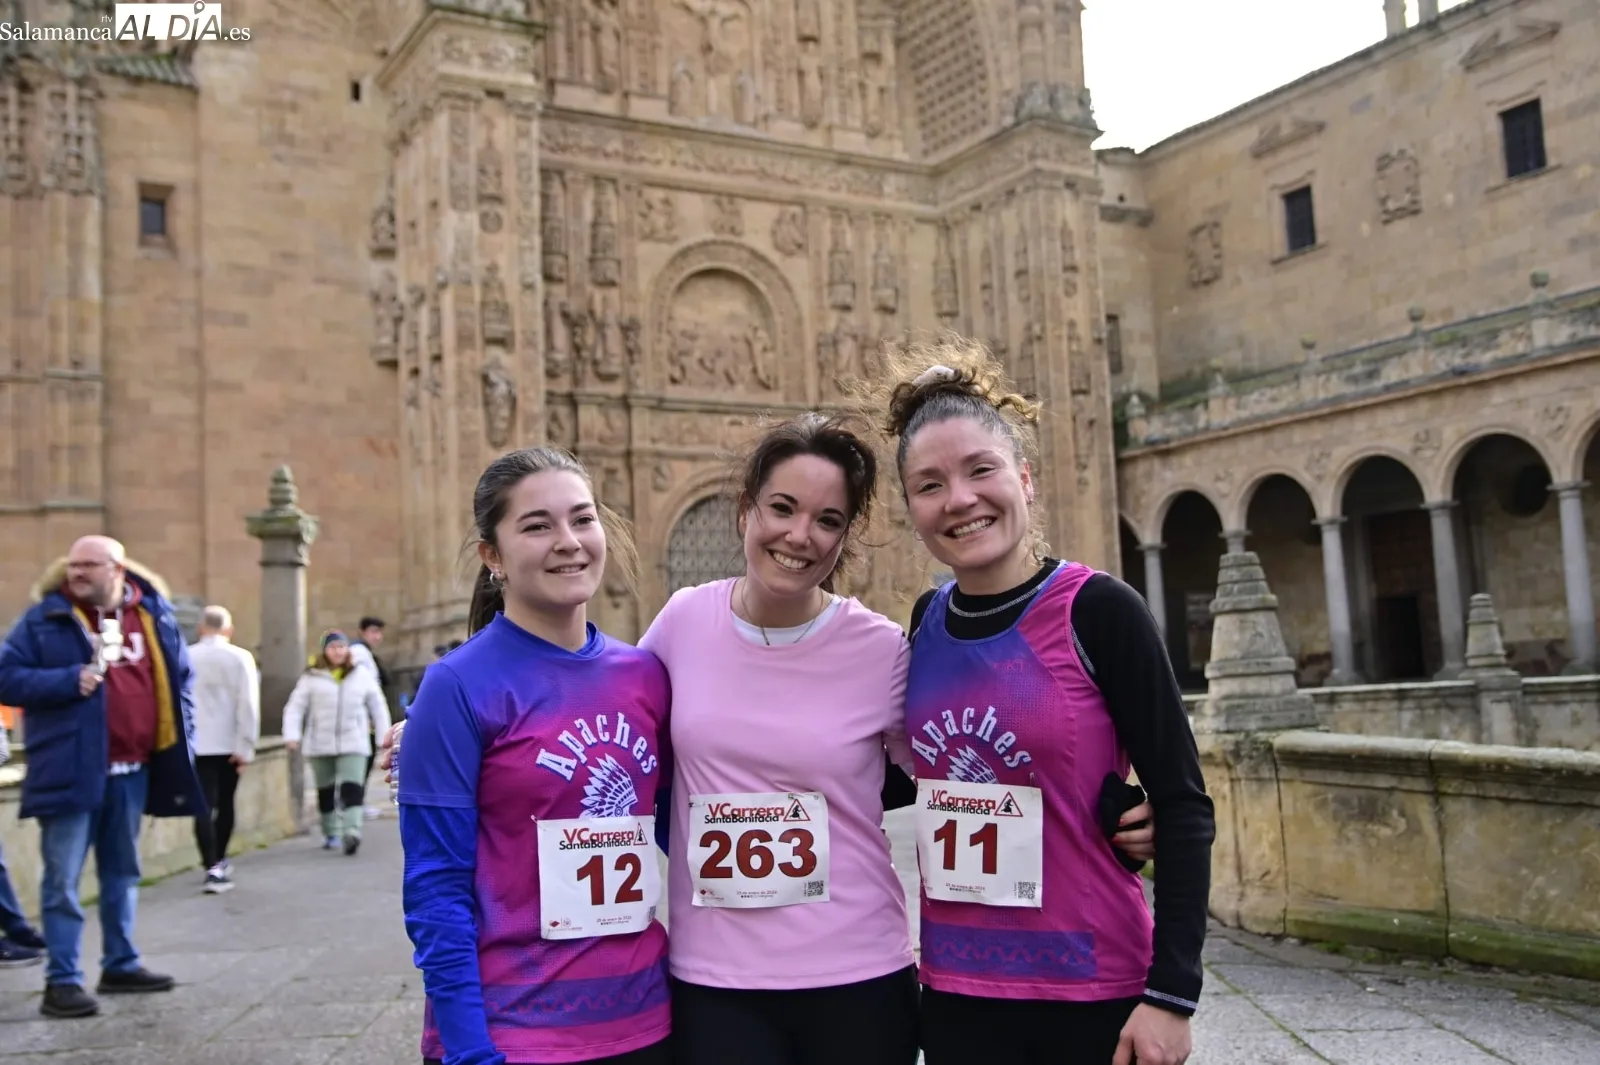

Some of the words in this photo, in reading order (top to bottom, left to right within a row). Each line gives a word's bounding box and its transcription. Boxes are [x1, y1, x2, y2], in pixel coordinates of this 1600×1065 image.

[535, 711, 658, 781] Apaches
[911, 705, 1032, 767] Apaches
[699, 828, 817, 879] 263
[934, 819, 998, 875] 11
[577, 853, 643, 906] 12
